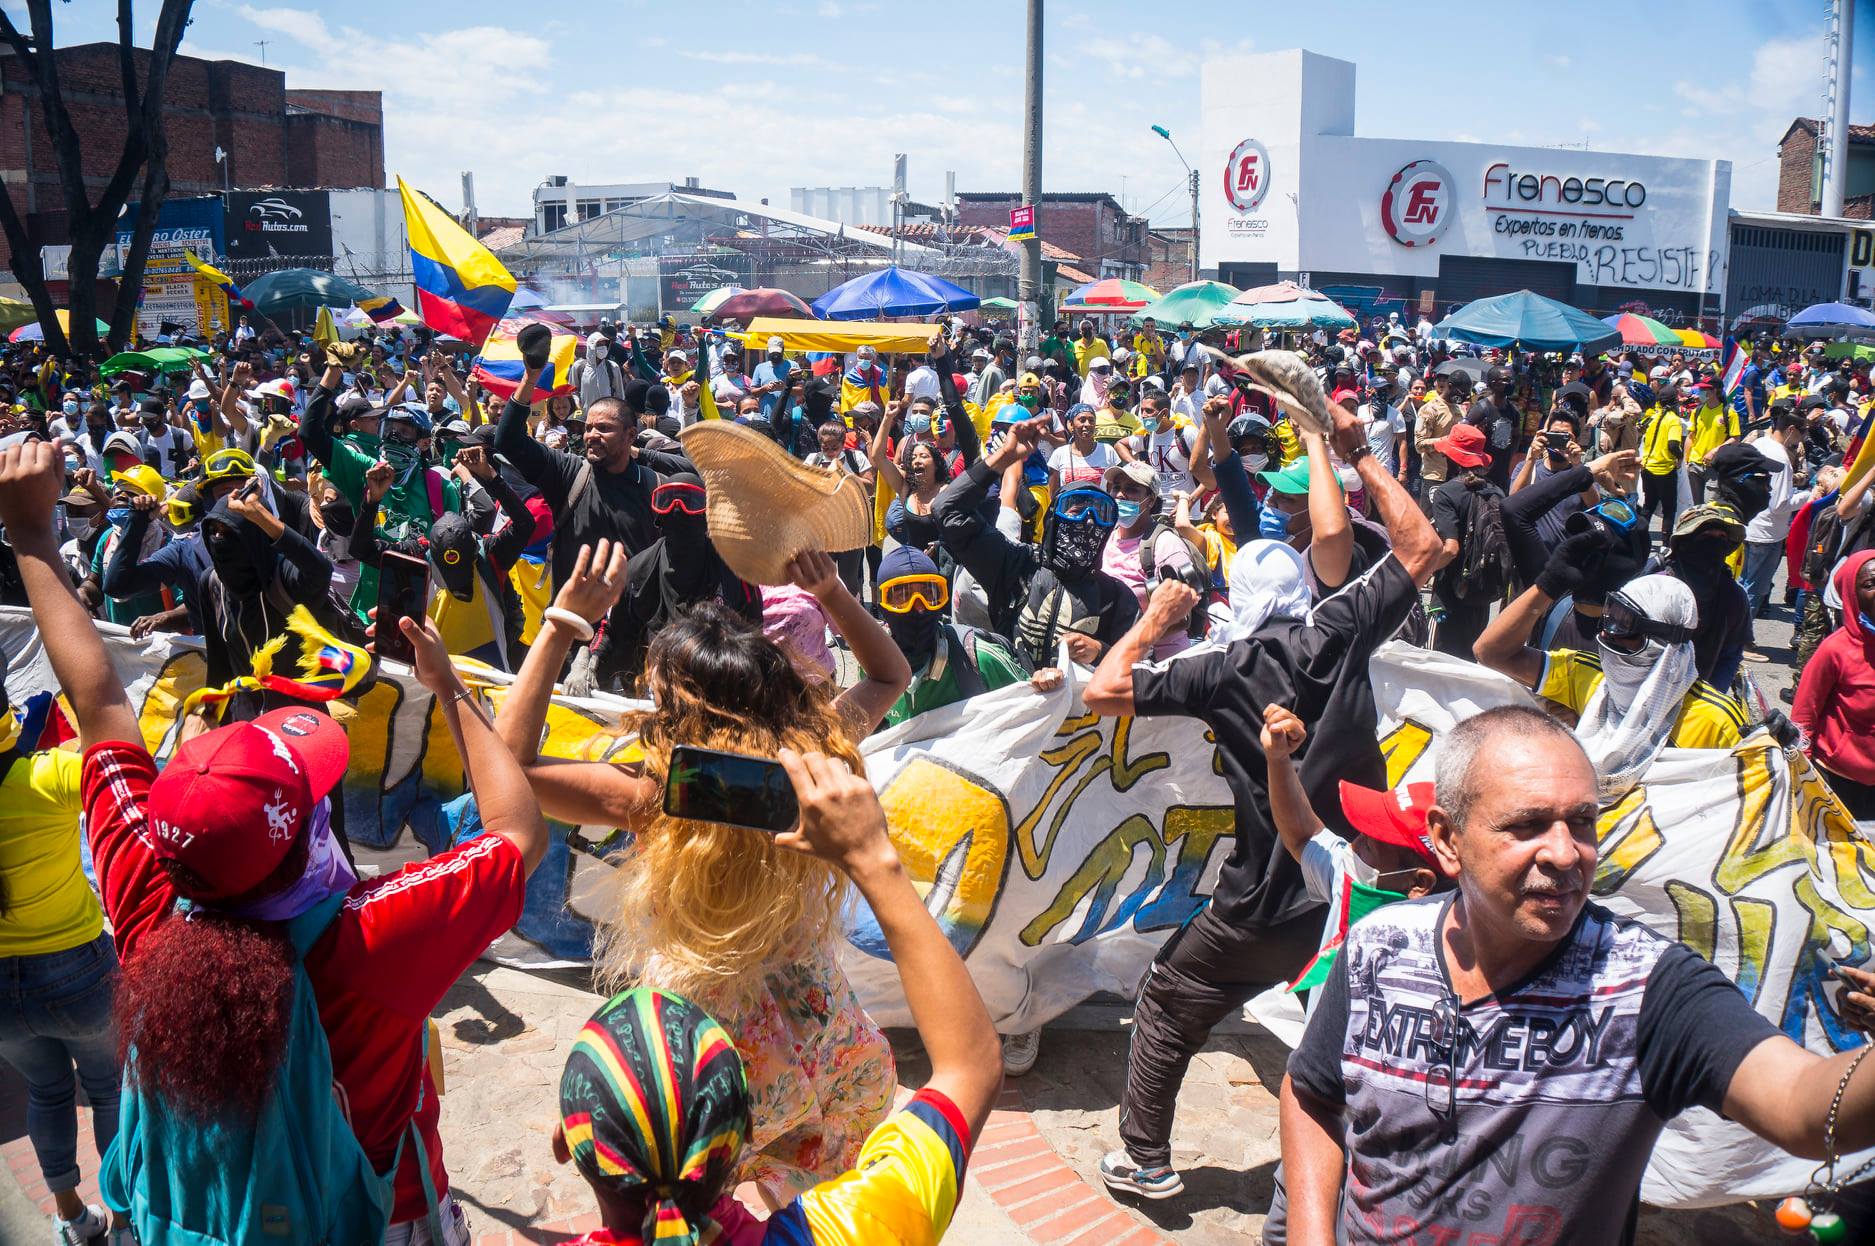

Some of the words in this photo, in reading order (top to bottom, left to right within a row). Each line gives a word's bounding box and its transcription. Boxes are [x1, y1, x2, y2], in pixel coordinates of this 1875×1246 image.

[1483, 163, 1647, 208] Frenesco
[1495, 214, 1557, 238] Expertos
[1559, 221, 1576, 237] en
[1578, 219, 1624, 240] frenos.
[154, 818, 195, 849] 1927
